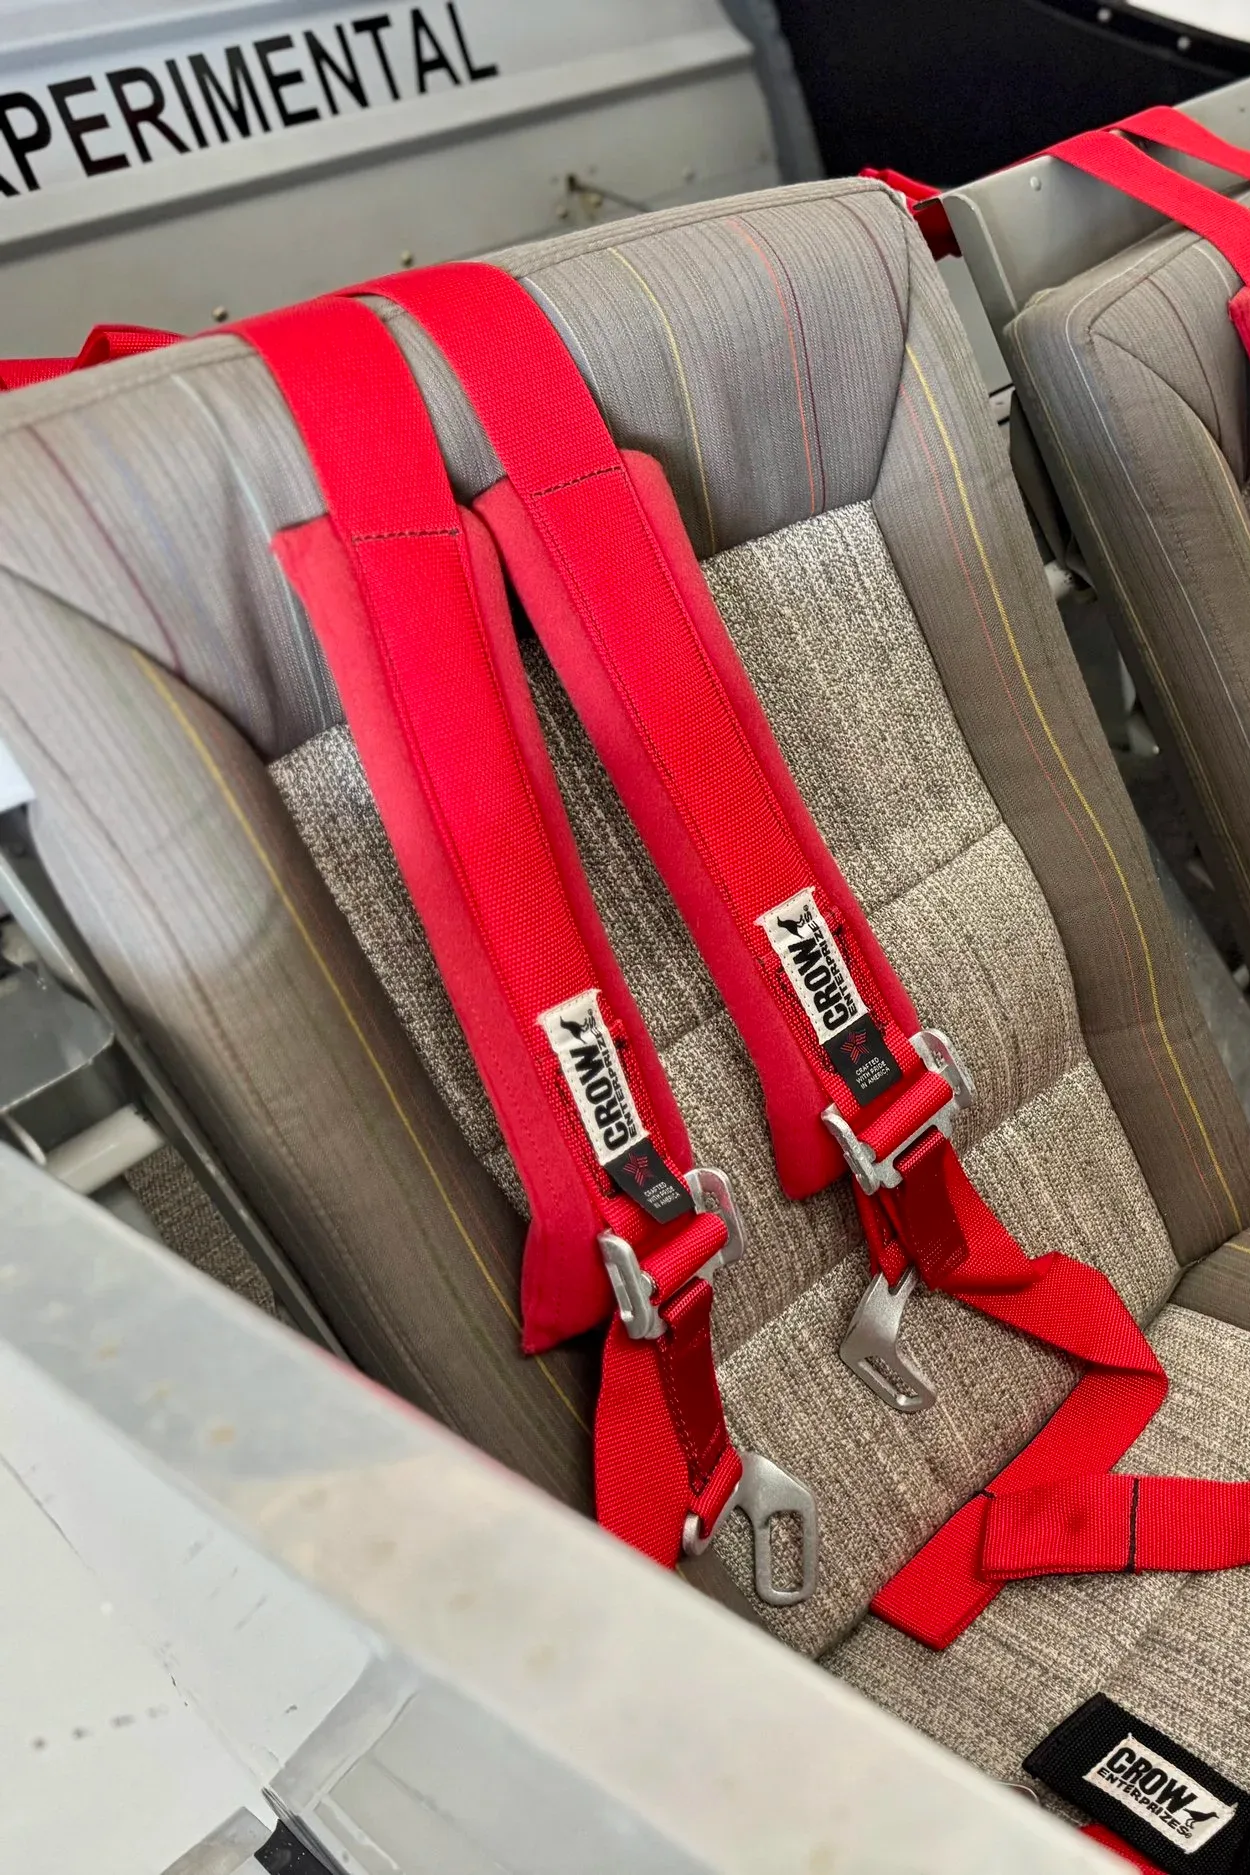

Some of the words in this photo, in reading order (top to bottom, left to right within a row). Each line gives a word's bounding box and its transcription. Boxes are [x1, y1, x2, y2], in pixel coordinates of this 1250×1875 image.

[0, 1, 499, 197] PERIMENTAL
[788, 938, 849, 1031] CROW
[570, 1044, 629, 1151] CROW
[856, 1057, 879, 1076] CRAFTED
[856, 1071, 870, 1084] WITH
[860, 1082, 868, 1090] IN
[868, 1067, 890, 1084] AMERICA
[1106, 1747, 1198, 1814] CROW
